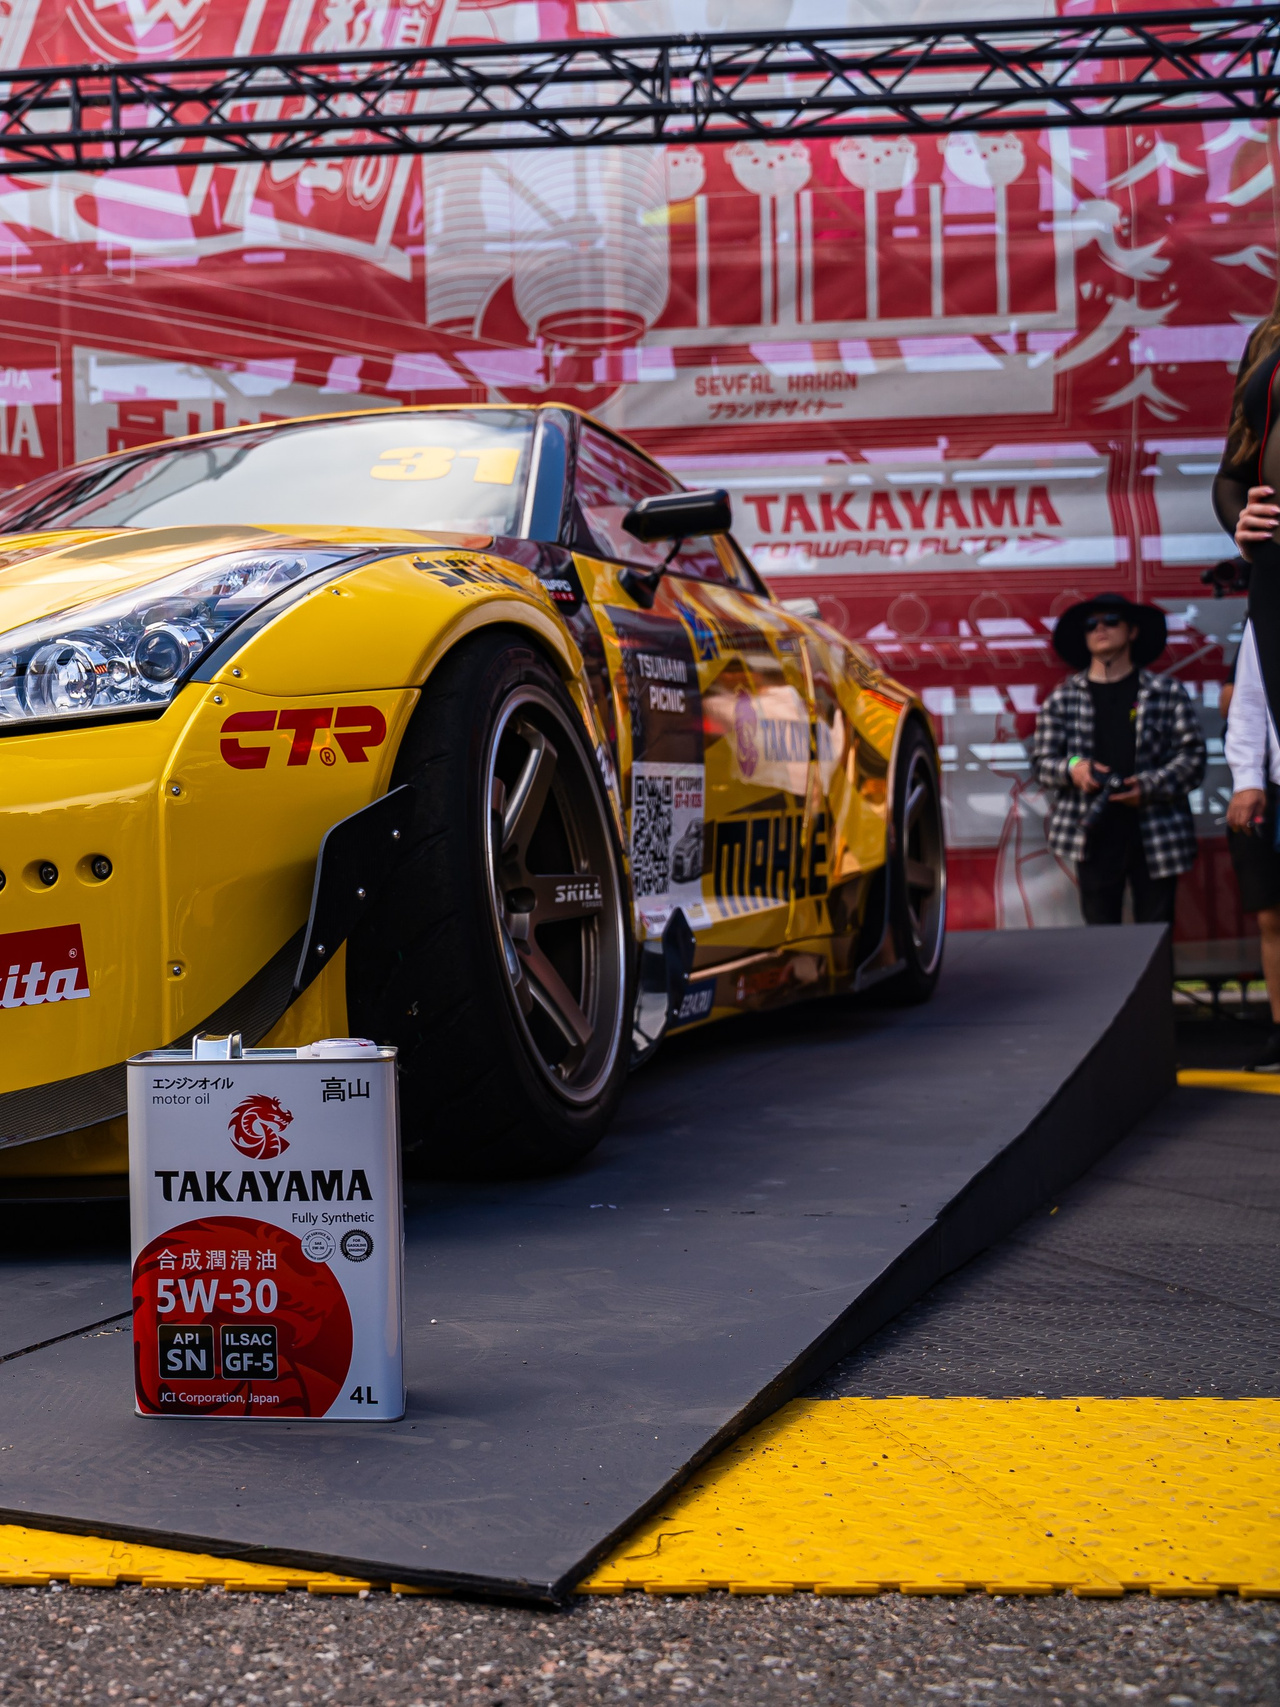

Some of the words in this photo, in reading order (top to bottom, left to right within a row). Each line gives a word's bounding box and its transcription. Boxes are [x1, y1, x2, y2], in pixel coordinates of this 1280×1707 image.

[370, 446, 521, 486] 31
[743, 486, 1063, 534] TAKAYAMA
[636, 653, 687, 683] TSUNAMI
[649, 685, 686, 713] PICNIC
[220, 705, 387, 769] CTR
[555, 883, 602, 903] SKILL
[152, 1077, 234, 1090] エンジンオイル
[321, 1077, 371, 1102] 高山
[152, 1094, 191, 1105] motor
[195, 1093, 210, 1105] oil
[154, 1169, 373, 1202] TAKAYAMA
[292, 1212, 318, 1226] Fully
[321, 1212, 375, 1226] Synthetic
[157, 1249, 277, 1271] 合成潤滑油
[157, 1278, 278, 1313] 5W-30
[173, 1332, 200, 1345] API
[225, 1332, 272, 1346] ILSAC
[166, 1349, 207, 1372] SN
[225, 1352, 274, 1372] GF-5
[160, 1393, 176, 1403] JCI
[178, 1392, 245, 1405] Corporation,
[248, 1392, 280, 1405] Japan
[350, 1386, 378, 1405] 4L
